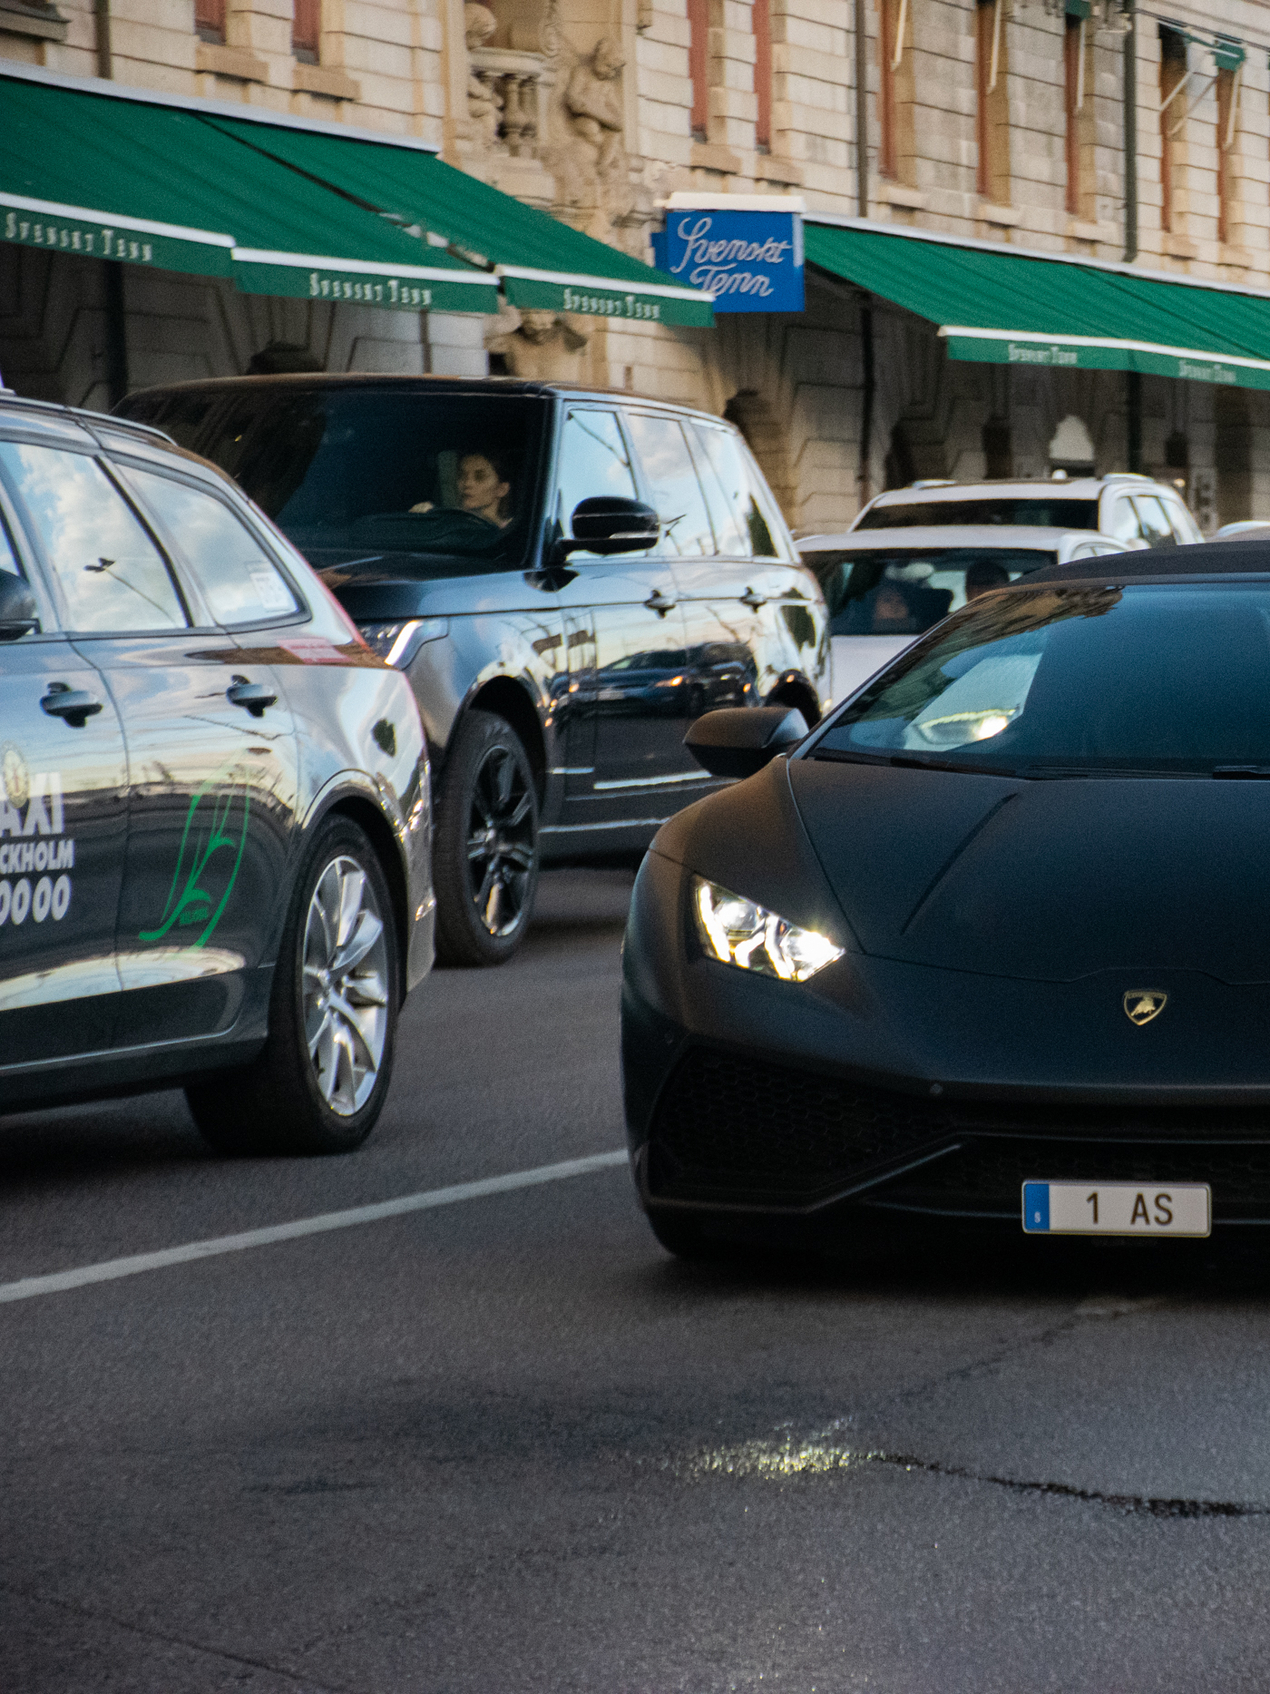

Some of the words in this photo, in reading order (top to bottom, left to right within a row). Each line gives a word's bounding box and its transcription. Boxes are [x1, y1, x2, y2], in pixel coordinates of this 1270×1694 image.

[669, 217, 793, 274] Svenskt
[689, 262, 775, 297] Tenn
[1086, 1191, 1099, 1225] 1
[1130, 1192, 1174, 1227] AS
